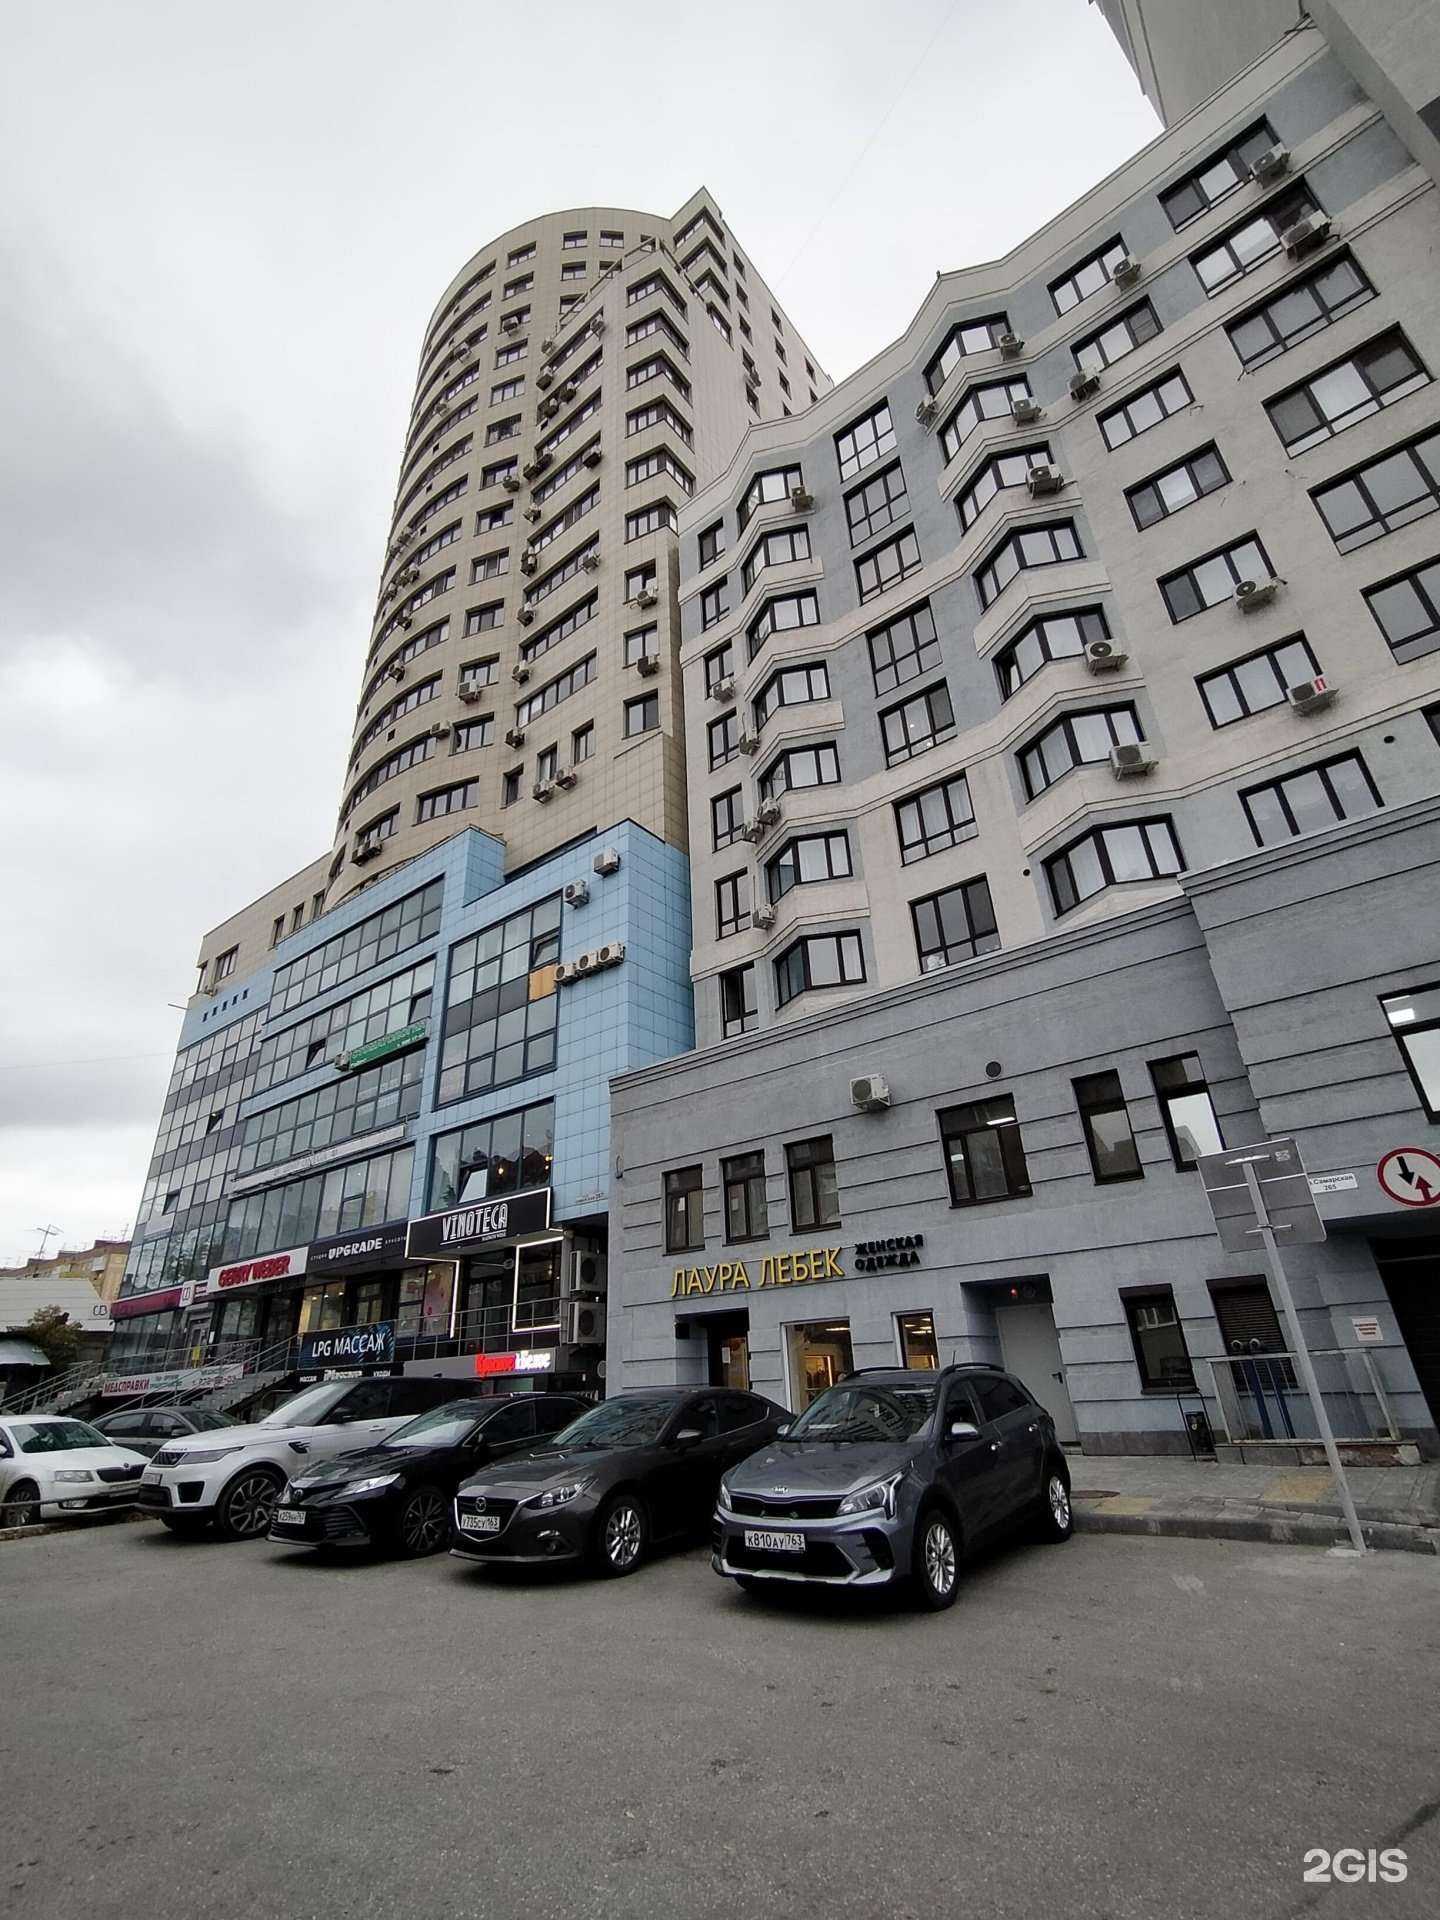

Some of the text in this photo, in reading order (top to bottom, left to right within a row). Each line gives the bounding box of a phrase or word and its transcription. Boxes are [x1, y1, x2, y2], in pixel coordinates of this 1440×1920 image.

[442, 1203, 508, 1241] VINOTECA
[328, 1238, 383, 1260] UPGRADE
[855, 1234, 923, 1255] ЖЕНСКАЯ
[672, 1247, 845, 1297] ЛАУРА ЛЕБЕК
[854, 1251, 920, 1272] ОДЕЖДА
[312, 1332, 385, 1357] LPG МАССАЖ
[104, 1380, 150, 1393] МЕДСПРАВКИ
